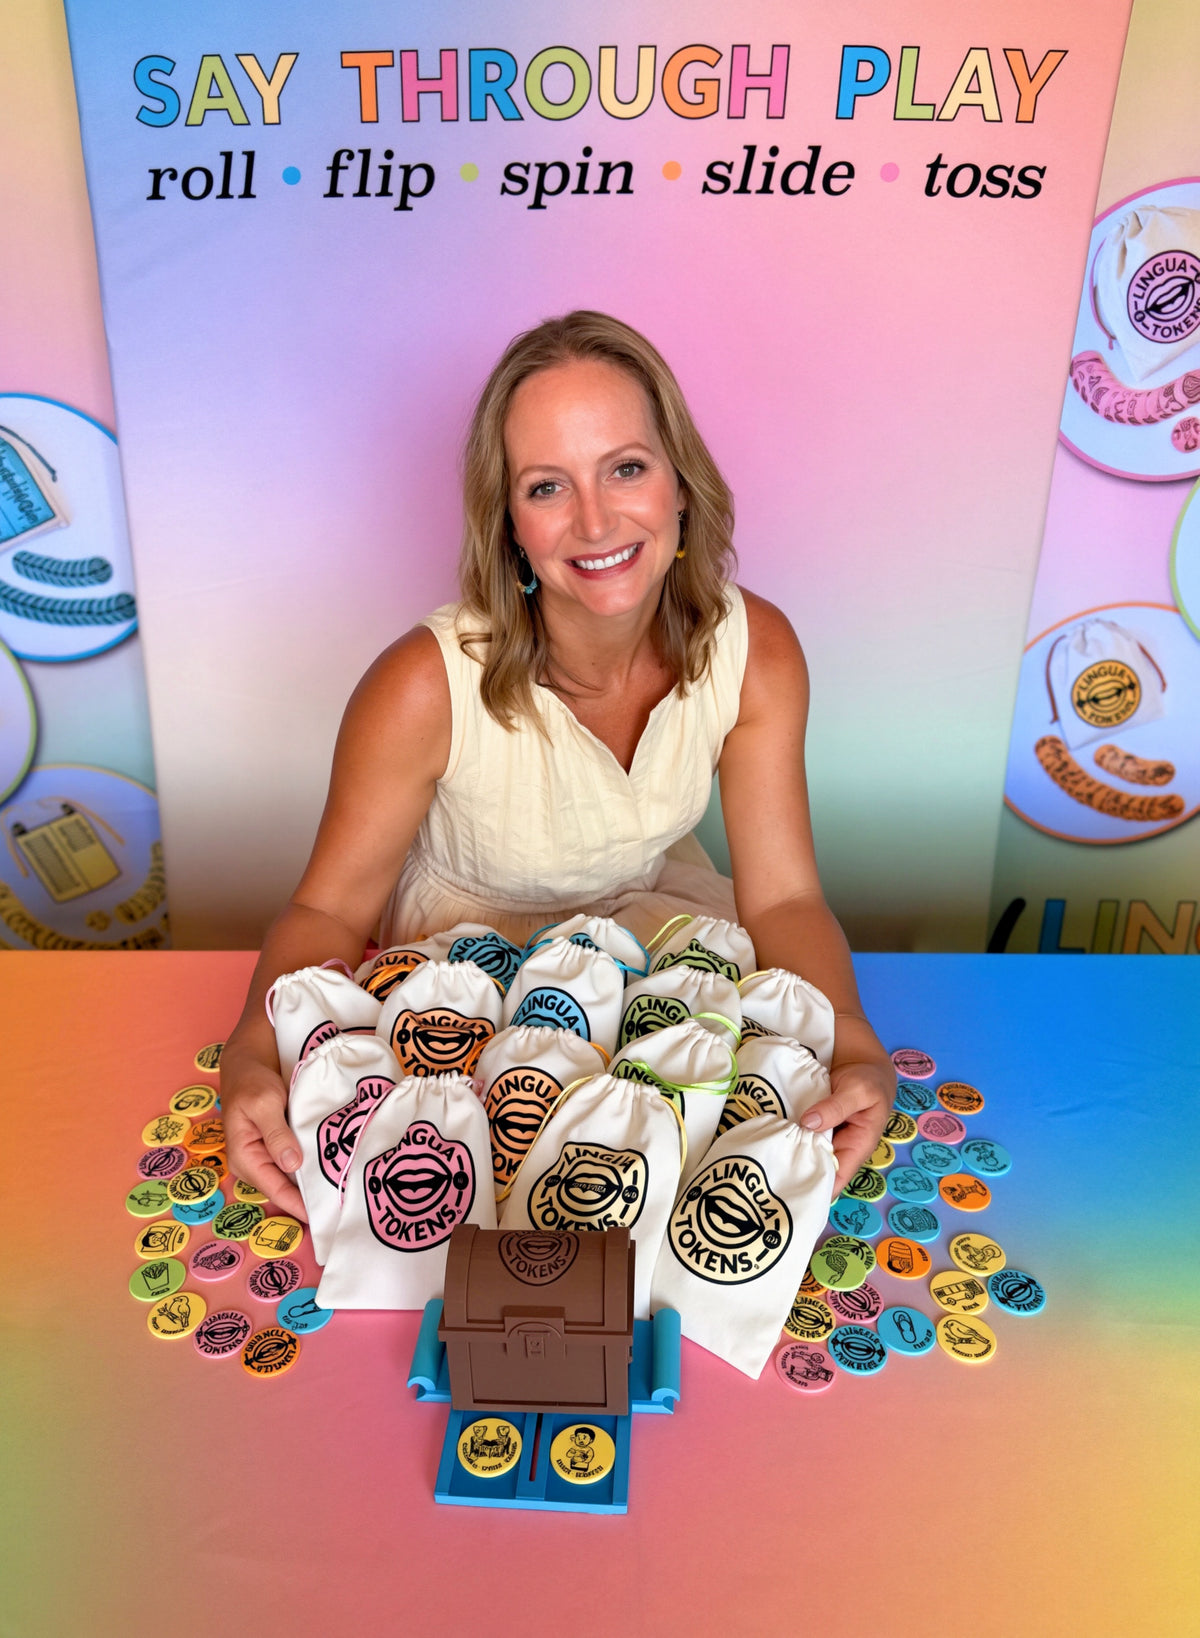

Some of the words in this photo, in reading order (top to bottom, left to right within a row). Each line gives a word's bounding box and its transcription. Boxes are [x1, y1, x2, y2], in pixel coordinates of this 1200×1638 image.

[134, 53, 299, 127] SAY
[341, 44, 790, 123] THROUGH
[836, 45, 1069, 123] PLAY
[147, 151, 256, 200] roll
[324, 149, 435, 211] flip
[501, 146, 633, 209] spin
[702, 145, 855, 196] slide
[925, 154, 1046, 199] toss
[1133, 257, 1187, 300] LINGUA
[1038, 899, 1200, 954] LIN
[521, 993, 579, 1029] LINGUA
[712, 1162, 778, 1220] LINGUA
[379, 1204, 456, 1242] TOKENS
[675, 1214, 753, 1274] TOKENS
[510, 1252, 566, 1278] TOKENS
